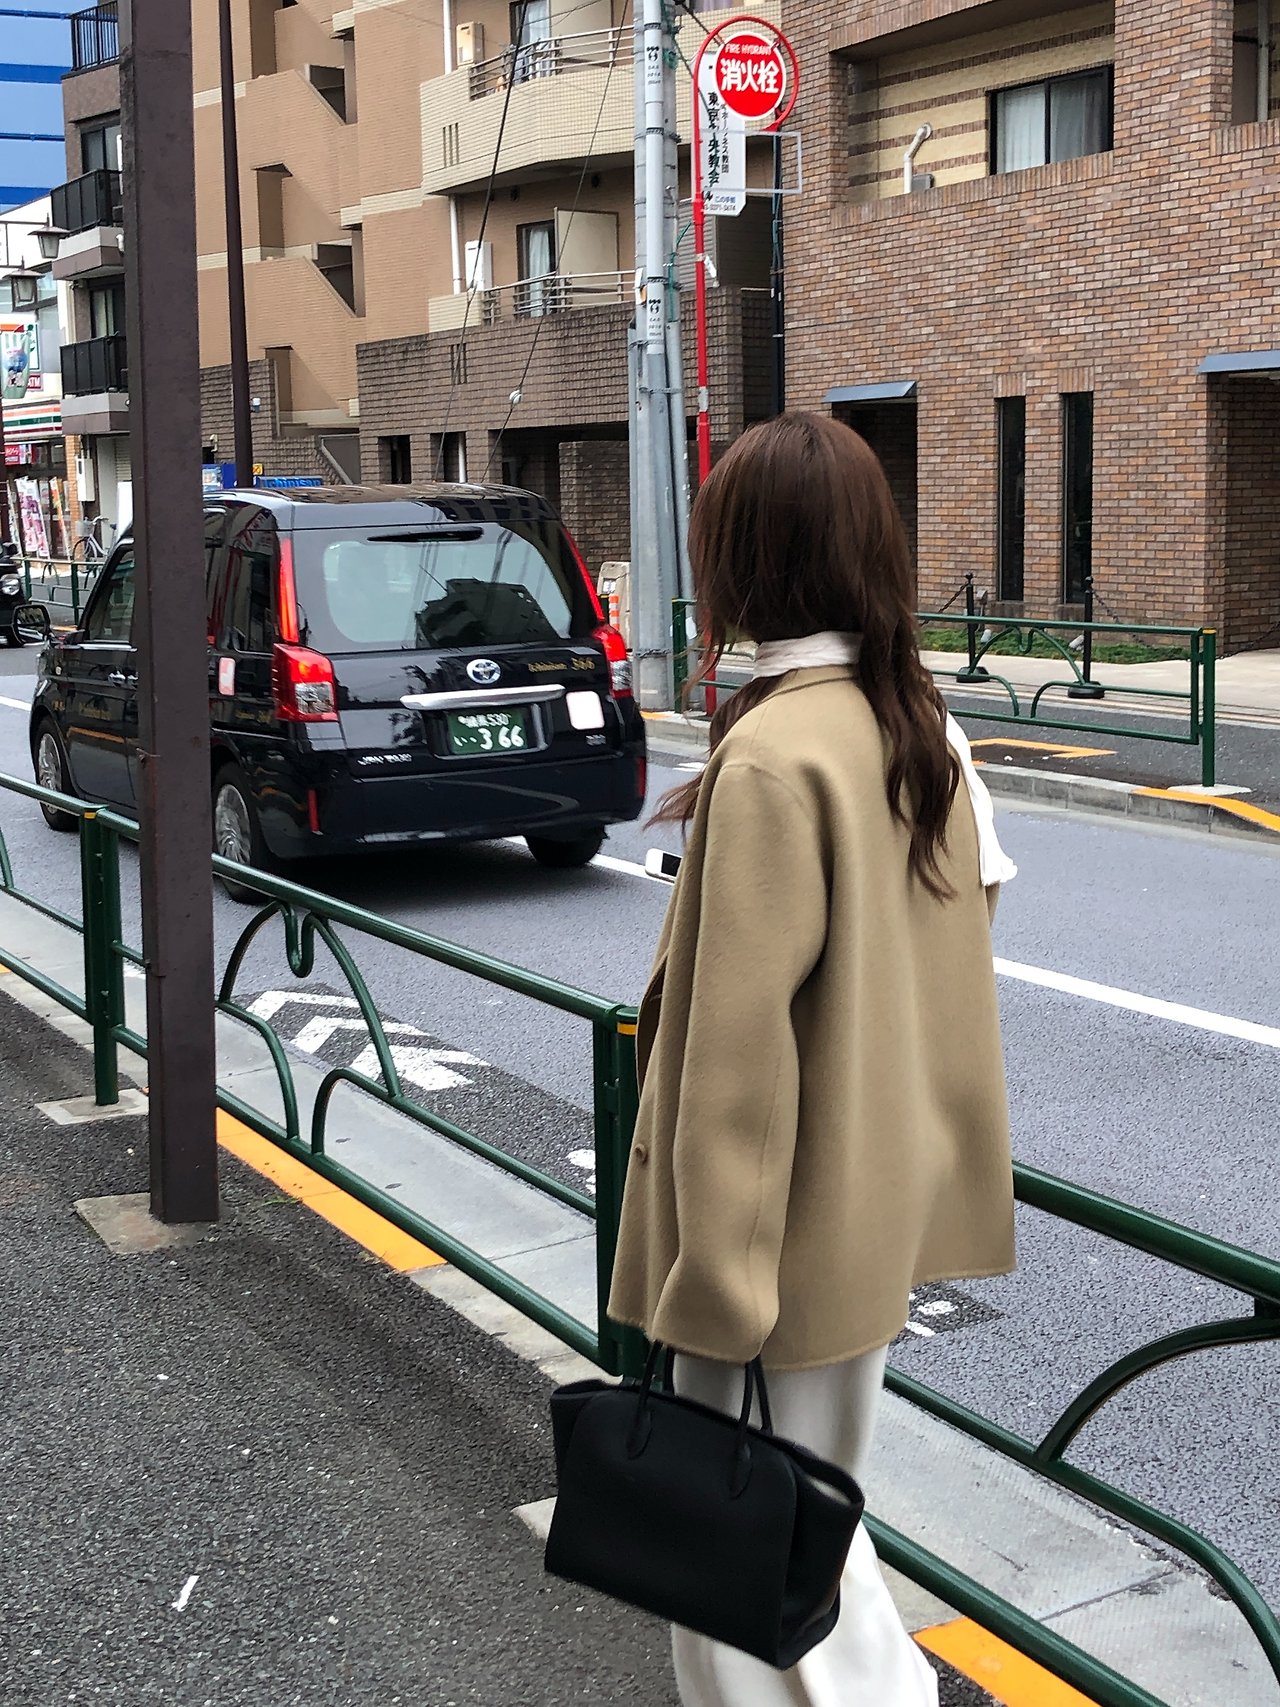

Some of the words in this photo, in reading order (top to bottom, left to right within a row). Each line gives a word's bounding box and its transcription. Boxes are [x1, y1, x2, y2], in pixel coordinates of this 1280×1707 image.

[725, 43, 741, 54] FIRE
[741, 44, 772, 56] HYDRANT
[720, 57, 779, 94] 消火栓
